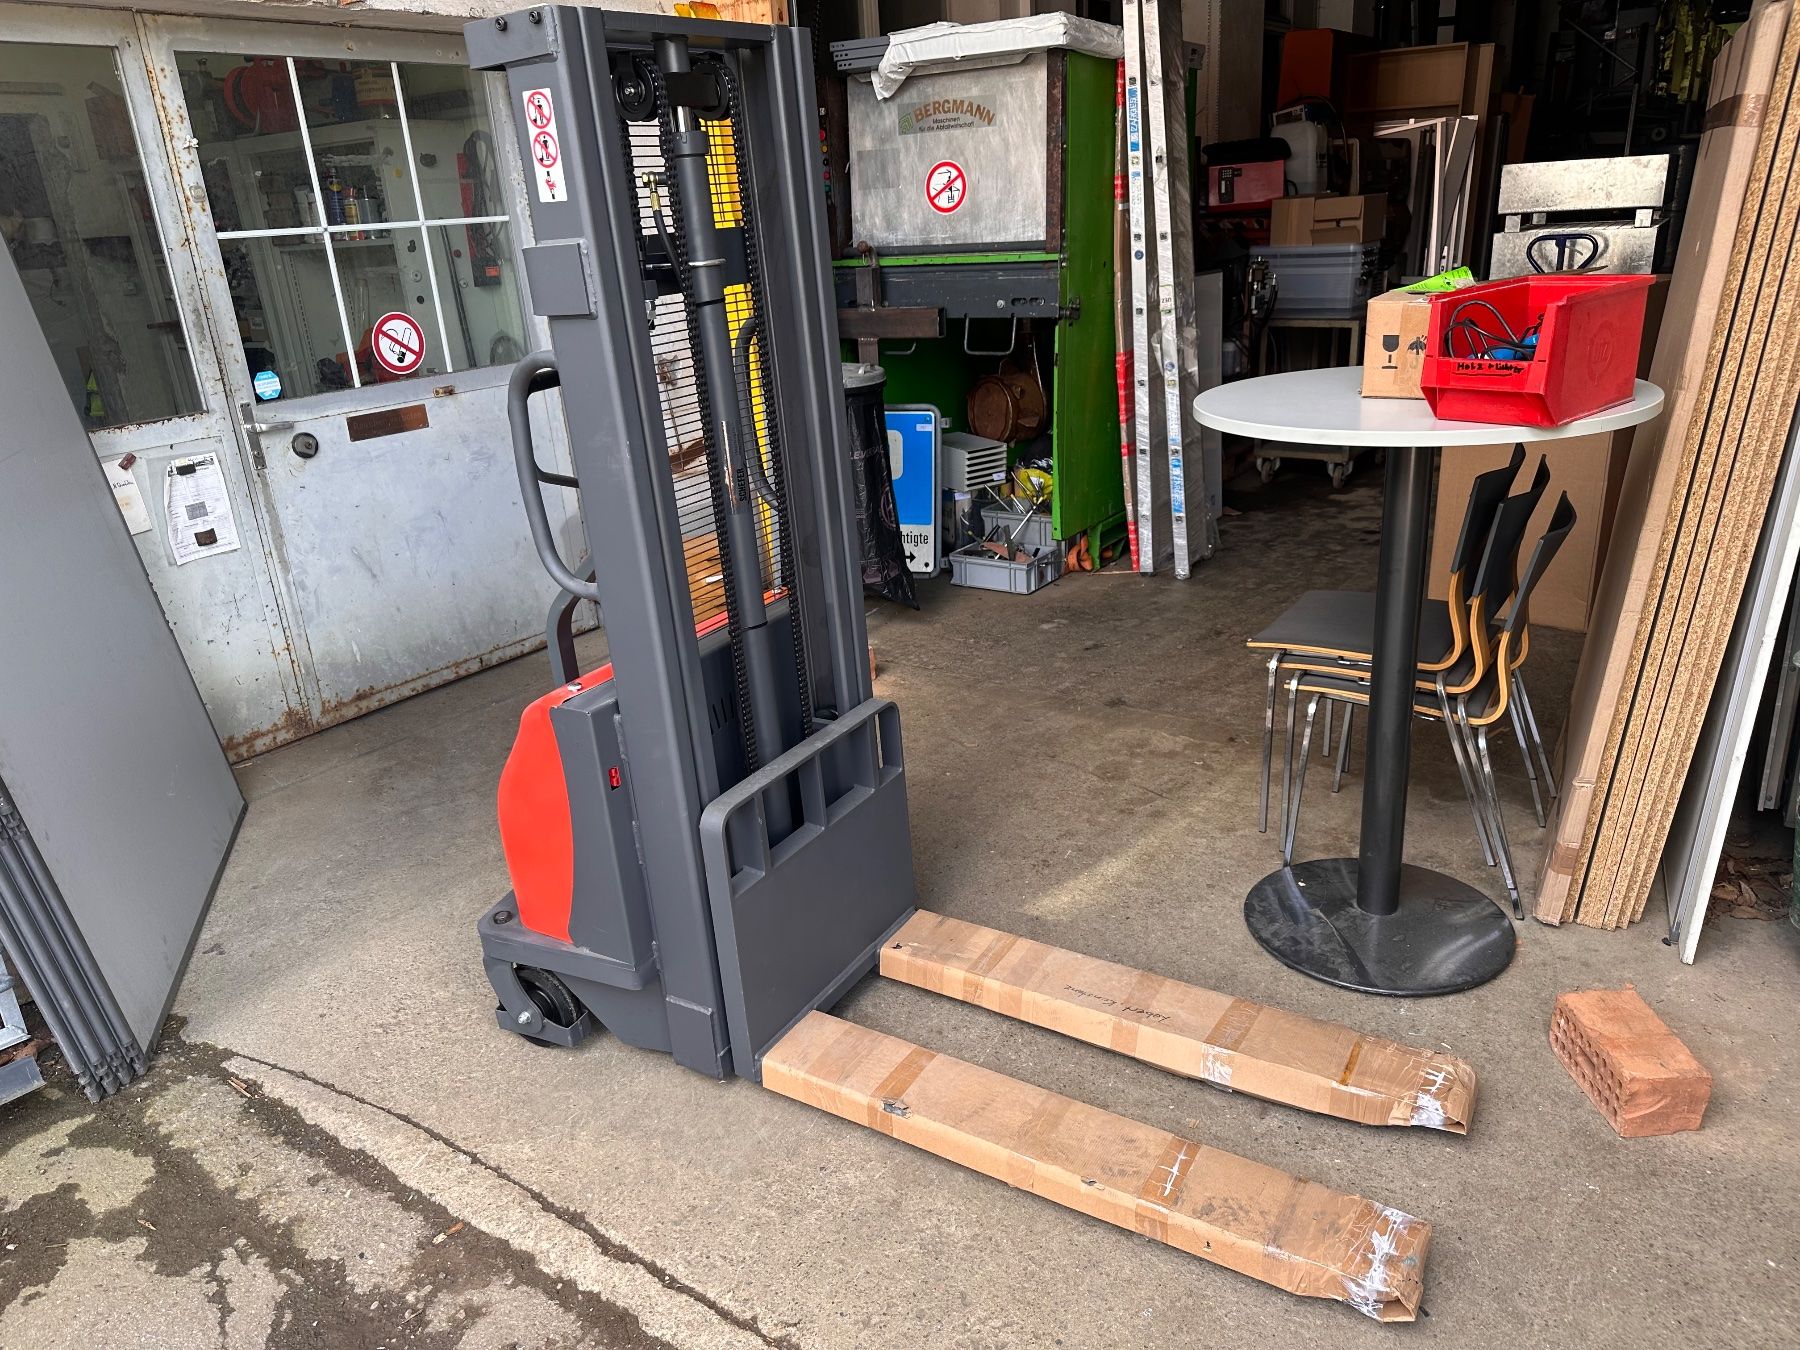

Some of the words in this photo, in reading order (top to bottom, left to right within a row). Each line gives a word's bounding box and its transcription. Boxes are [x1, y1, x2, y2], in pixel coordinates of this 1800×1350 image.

[913, 99, 995, 126] BERGMANN
[932, 116, 960, 124] Maschinen
[736, 468, 747, 501] SCHEFER
